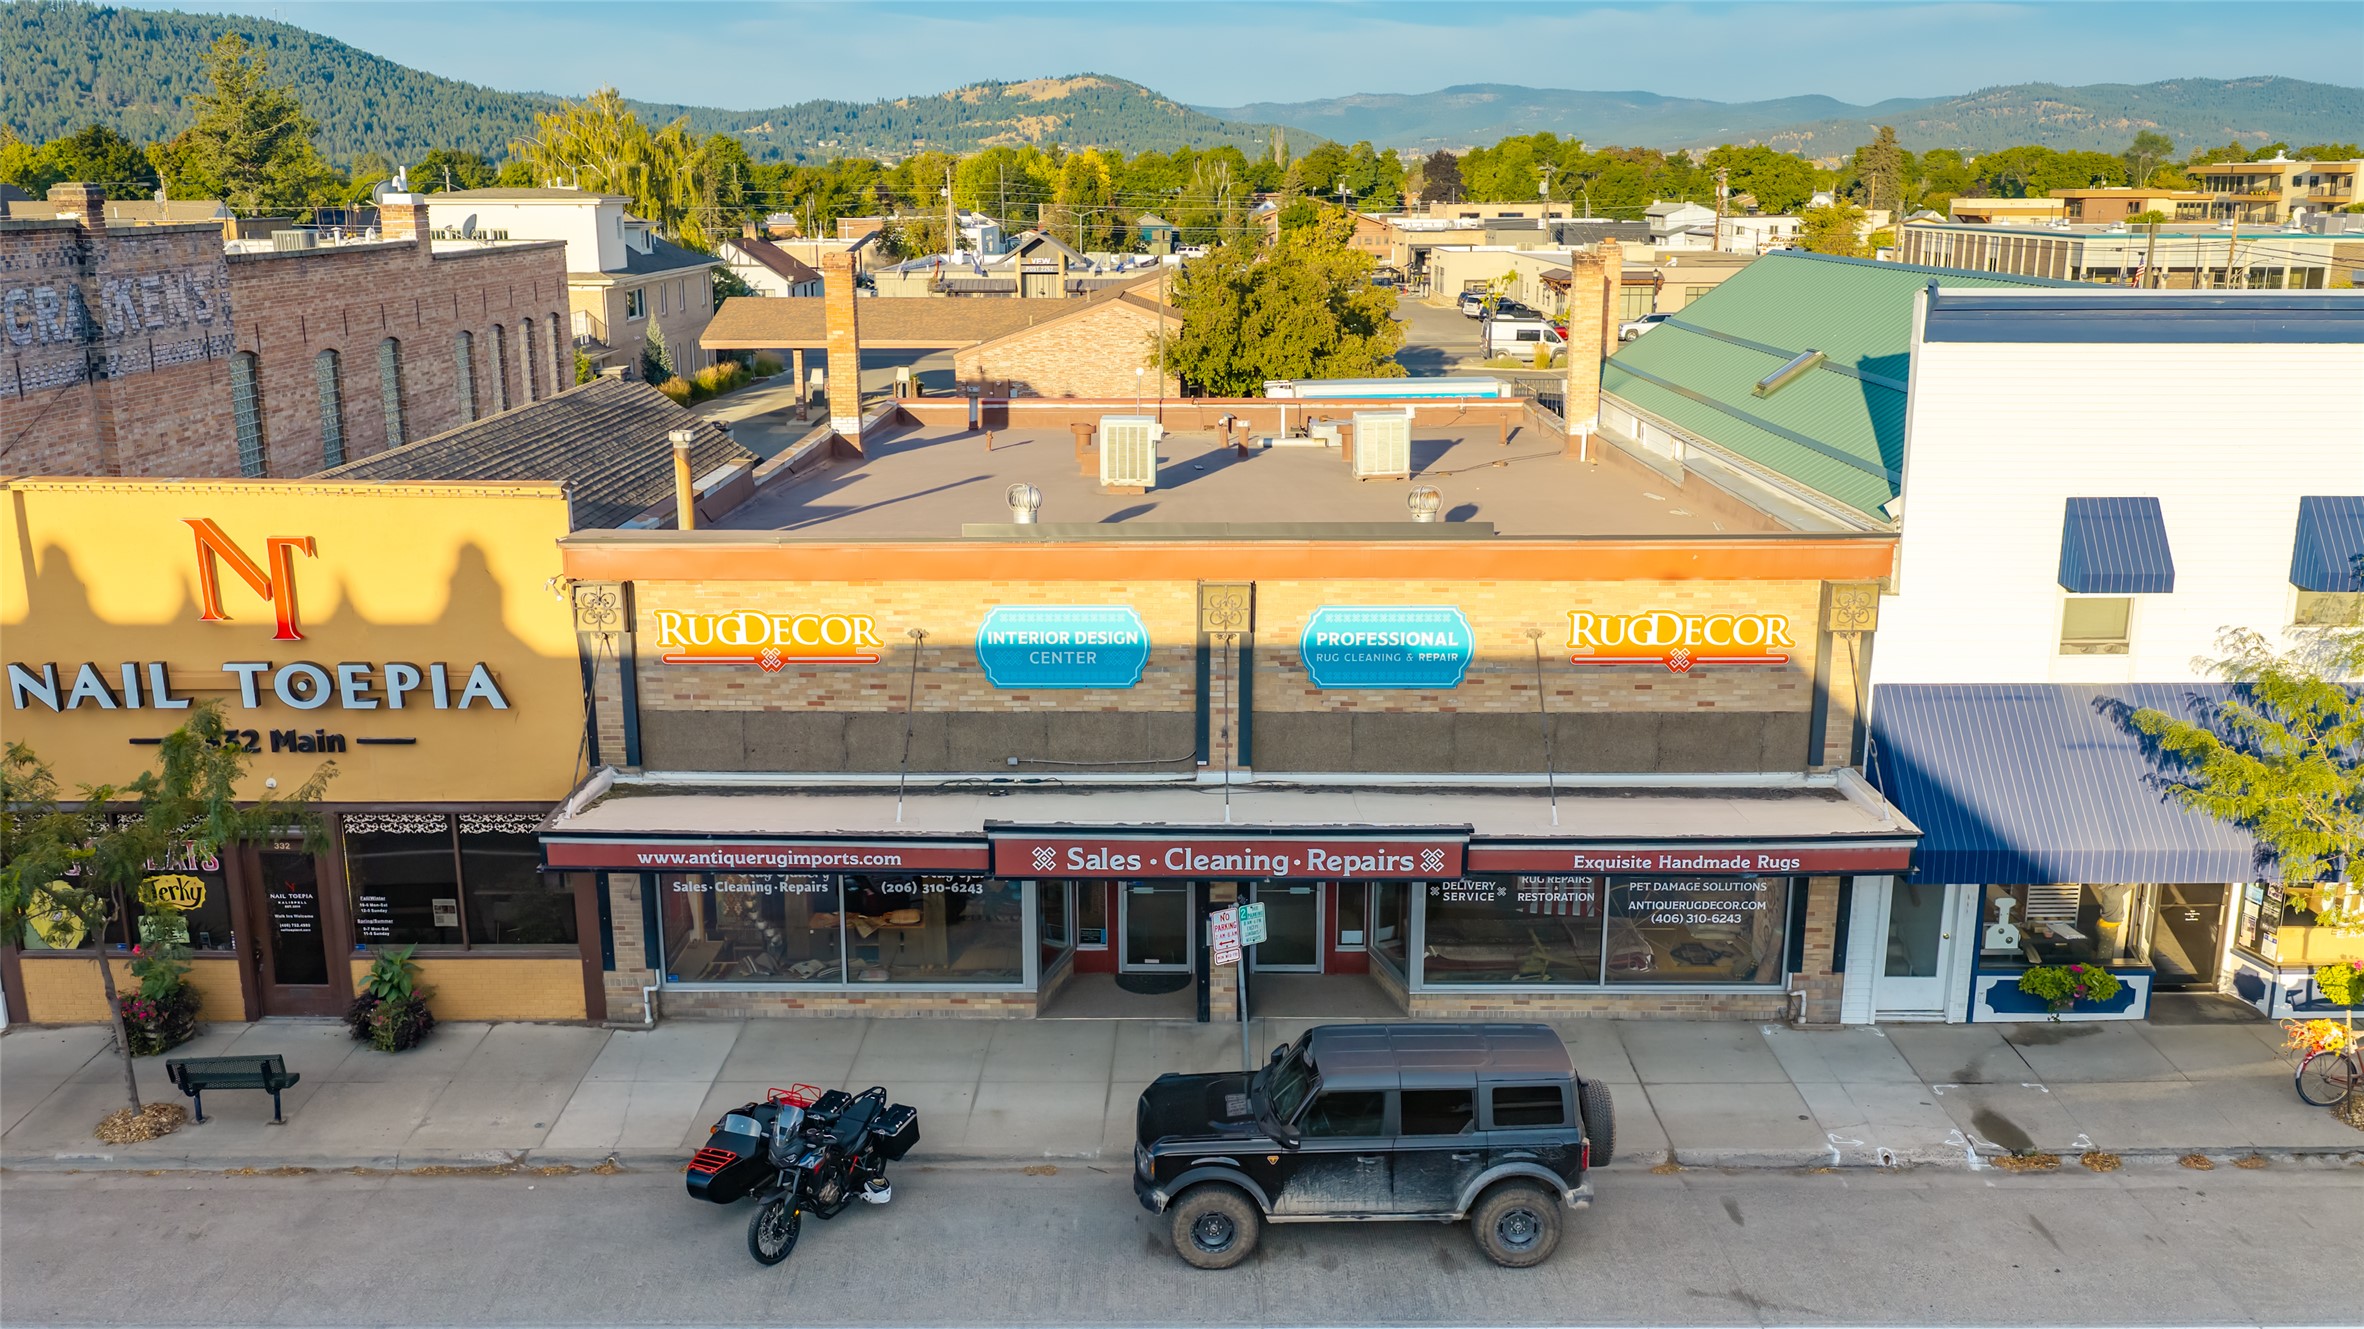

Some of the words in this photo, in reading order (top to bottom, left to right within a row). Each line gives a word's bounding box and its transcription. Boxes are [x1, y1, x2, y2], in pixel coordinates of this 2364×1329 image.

[987, 631, 1071, 646] INTERIOR
[1075, 631, 1139, 646] DESIGN
[1316, 631, 1459, 647] PROFESSIONAL
[1029, 651, 1097, 665] CENTER
[1316, 653, 1340, 663] RUG
[1344, 653, 1402, 663] CLEANING
[1406, 653, 1414, 663] &
[1418, 653, 1458, 663] REPAIR
[7, 661, 194, 713] NAIL
[222, 661, 510, 710] TOEPIA
[270, 729, 347, 753] Main
[274, 842, 291, 850] 332
[637, 851, 902, 867] www.antiquerugimports.com
[1066, 847, 1142, 871] Sales
[1165, 847, 1289, 876] Cleaning
[1307, 848, 1414, 876] Repairs
[1573, 856, 1652, 872] Exquisite
[1659, 856, 1751, 870] Handmade
[1757, 856, 1801, 872] Rugs
[673, 881, 708, 893] Sales
[714, 881, 772, 895] Cleaning
[779, 881, 829, 895] Repairs
[881, 881, 917, 895] (206)
[922, 881, 983, 895] 310-6243
[1442, 881, 1496, 890] DELIVERY
[1629, 883, 1651, 891] PET
[1654, 883, 1700, 891] DAMAGE
[1702, 883, 1767, 891] SOLUTIONS
[1442, 892, 1495, 901] SERVICE
[1517, 892, 1595, 902] RESTORATION
[1628, 901, 1766, 910] ANTIQUERUGDECOR.COM
[1220, 913, 1230, 922] NO
[1240, 908, 1246, 920] 2
[1651, 914, 1684, 924] (406)
[1686, 914, 1742, 924] 310-6243
[1214, 921, 1237, 931] PARKING
